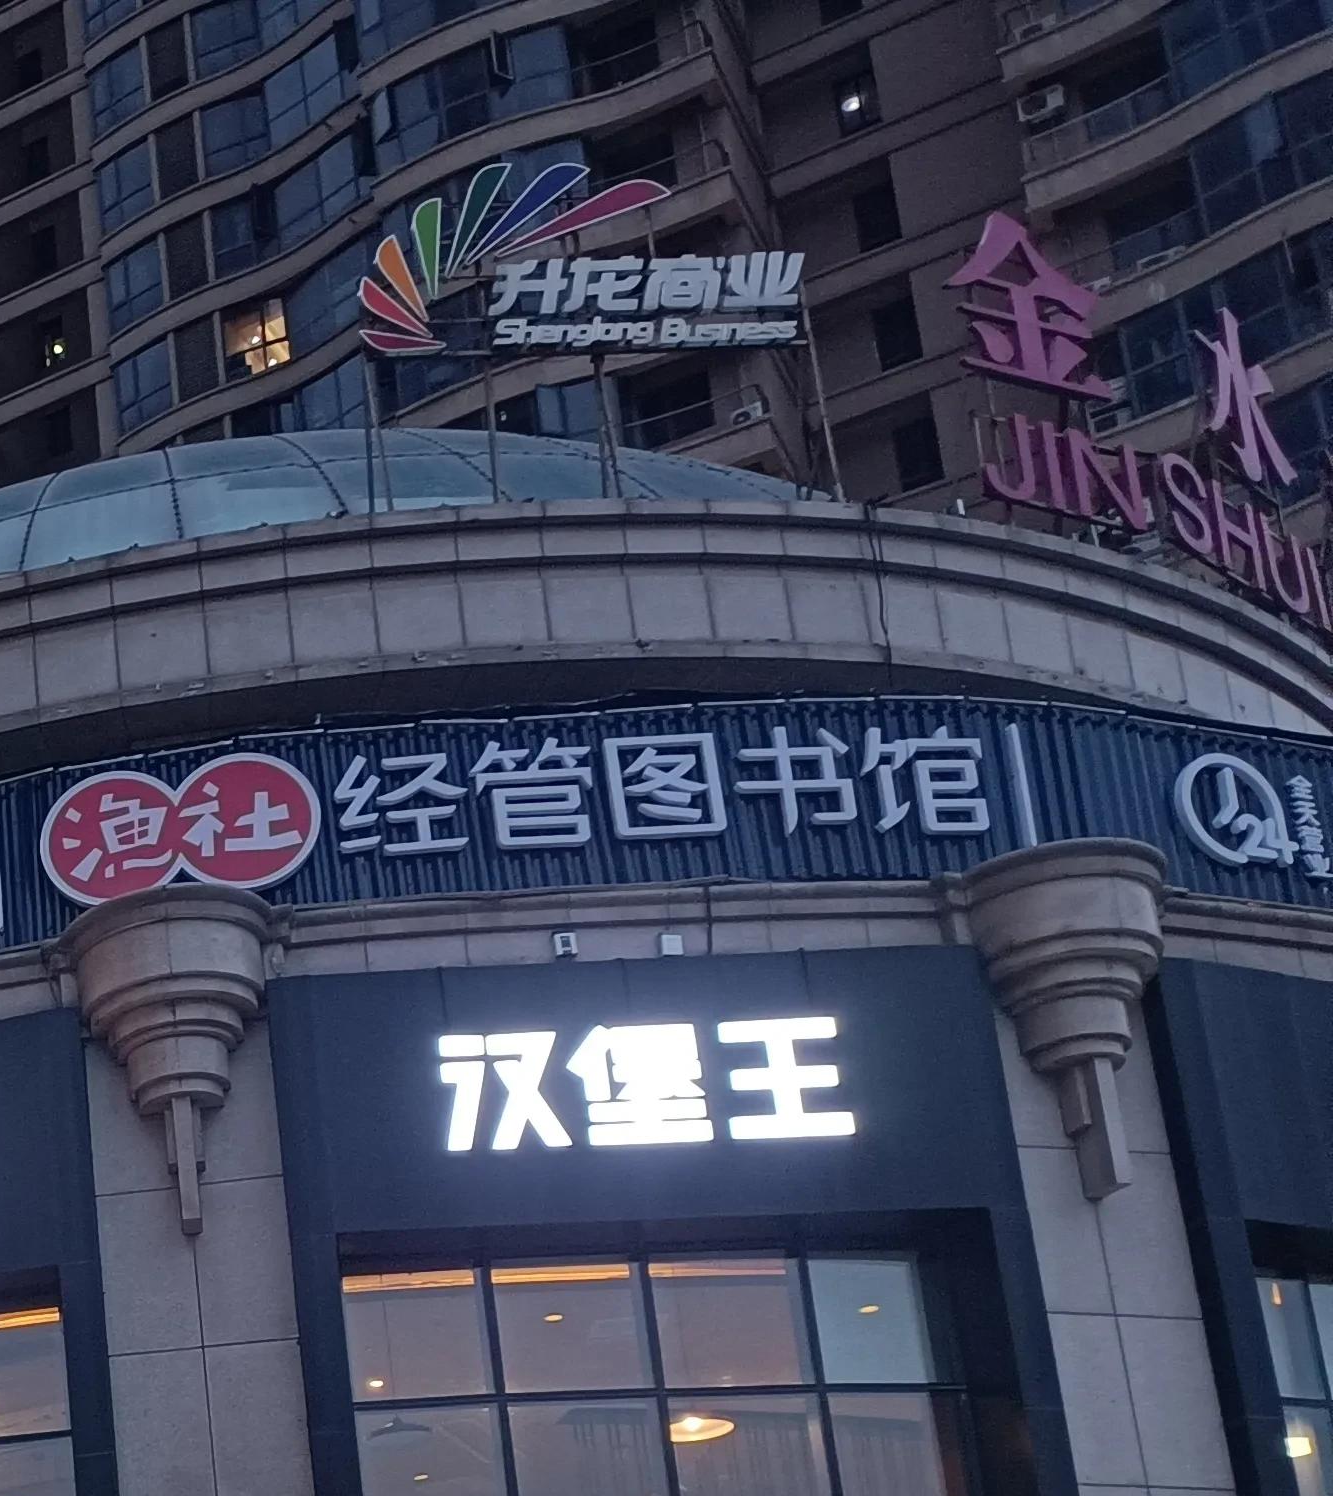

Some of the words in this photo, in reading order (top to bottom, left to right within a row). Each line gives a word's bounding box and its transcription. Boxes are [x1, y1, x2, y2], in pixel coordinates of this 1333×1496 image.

[490, 252, 806, 316] 升龙商业
[493, 314, 653, 348] Shenglong
[660, 316, 800, 345] Business
[946, 210, 1298, 486] 金水
[983, 412, 1148, 531] JIN
[1162, 452, 1333, 632] SHUI
[61, 781, 304, 880] 渔社
[333, 725, 990, 858] 经管图书馆
[437, 1015, 856, 1152] 汉堡王
